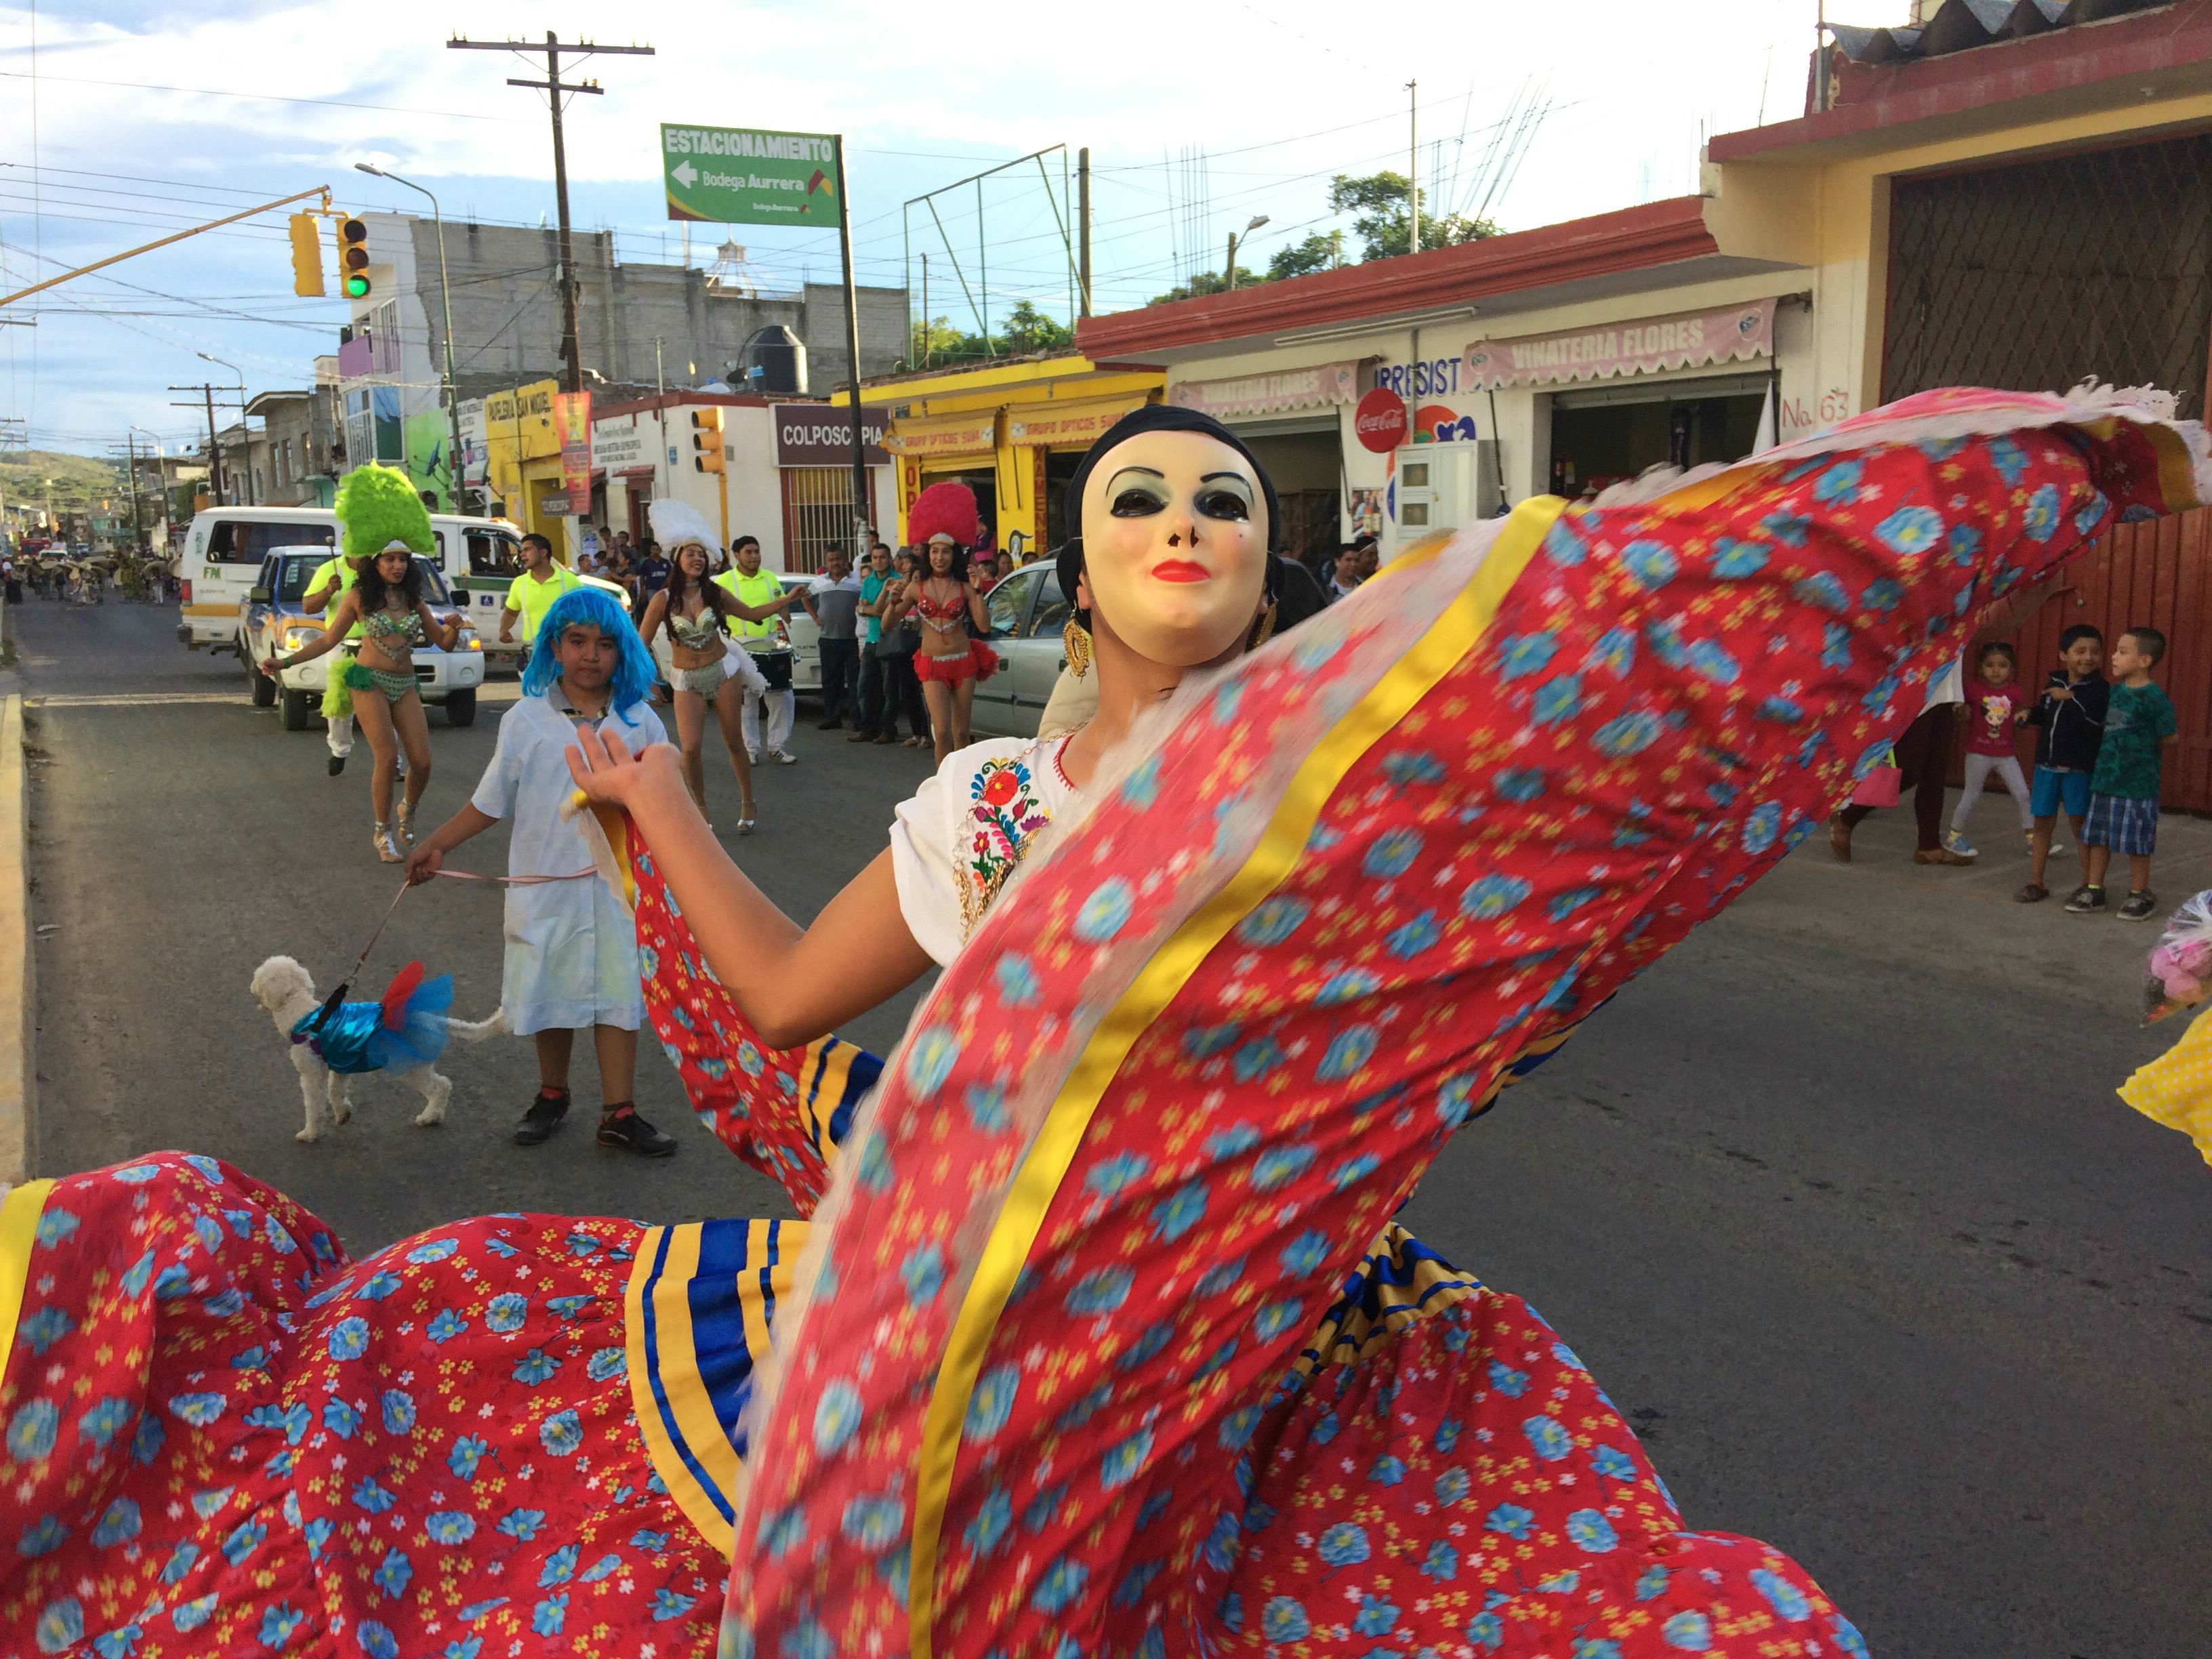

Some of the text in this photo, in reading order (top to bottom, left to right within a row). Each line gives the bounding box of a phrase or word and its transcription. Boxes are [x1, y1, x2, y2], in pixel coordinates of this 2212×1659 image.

[664, 128, 833, 163] ESTACIONAMIENTO
[702, 171, 804, 192] Bodega Aurrera
[1512, 332, 1618, 369] VINATERIA
[1624, 319, 1704, 356] FLORES
[1820, 391, 1849, 423] 63
[783, 425, 882, 446] COLPOSCPIA
[1357, 409, 1404, 434] Coca-Cola
